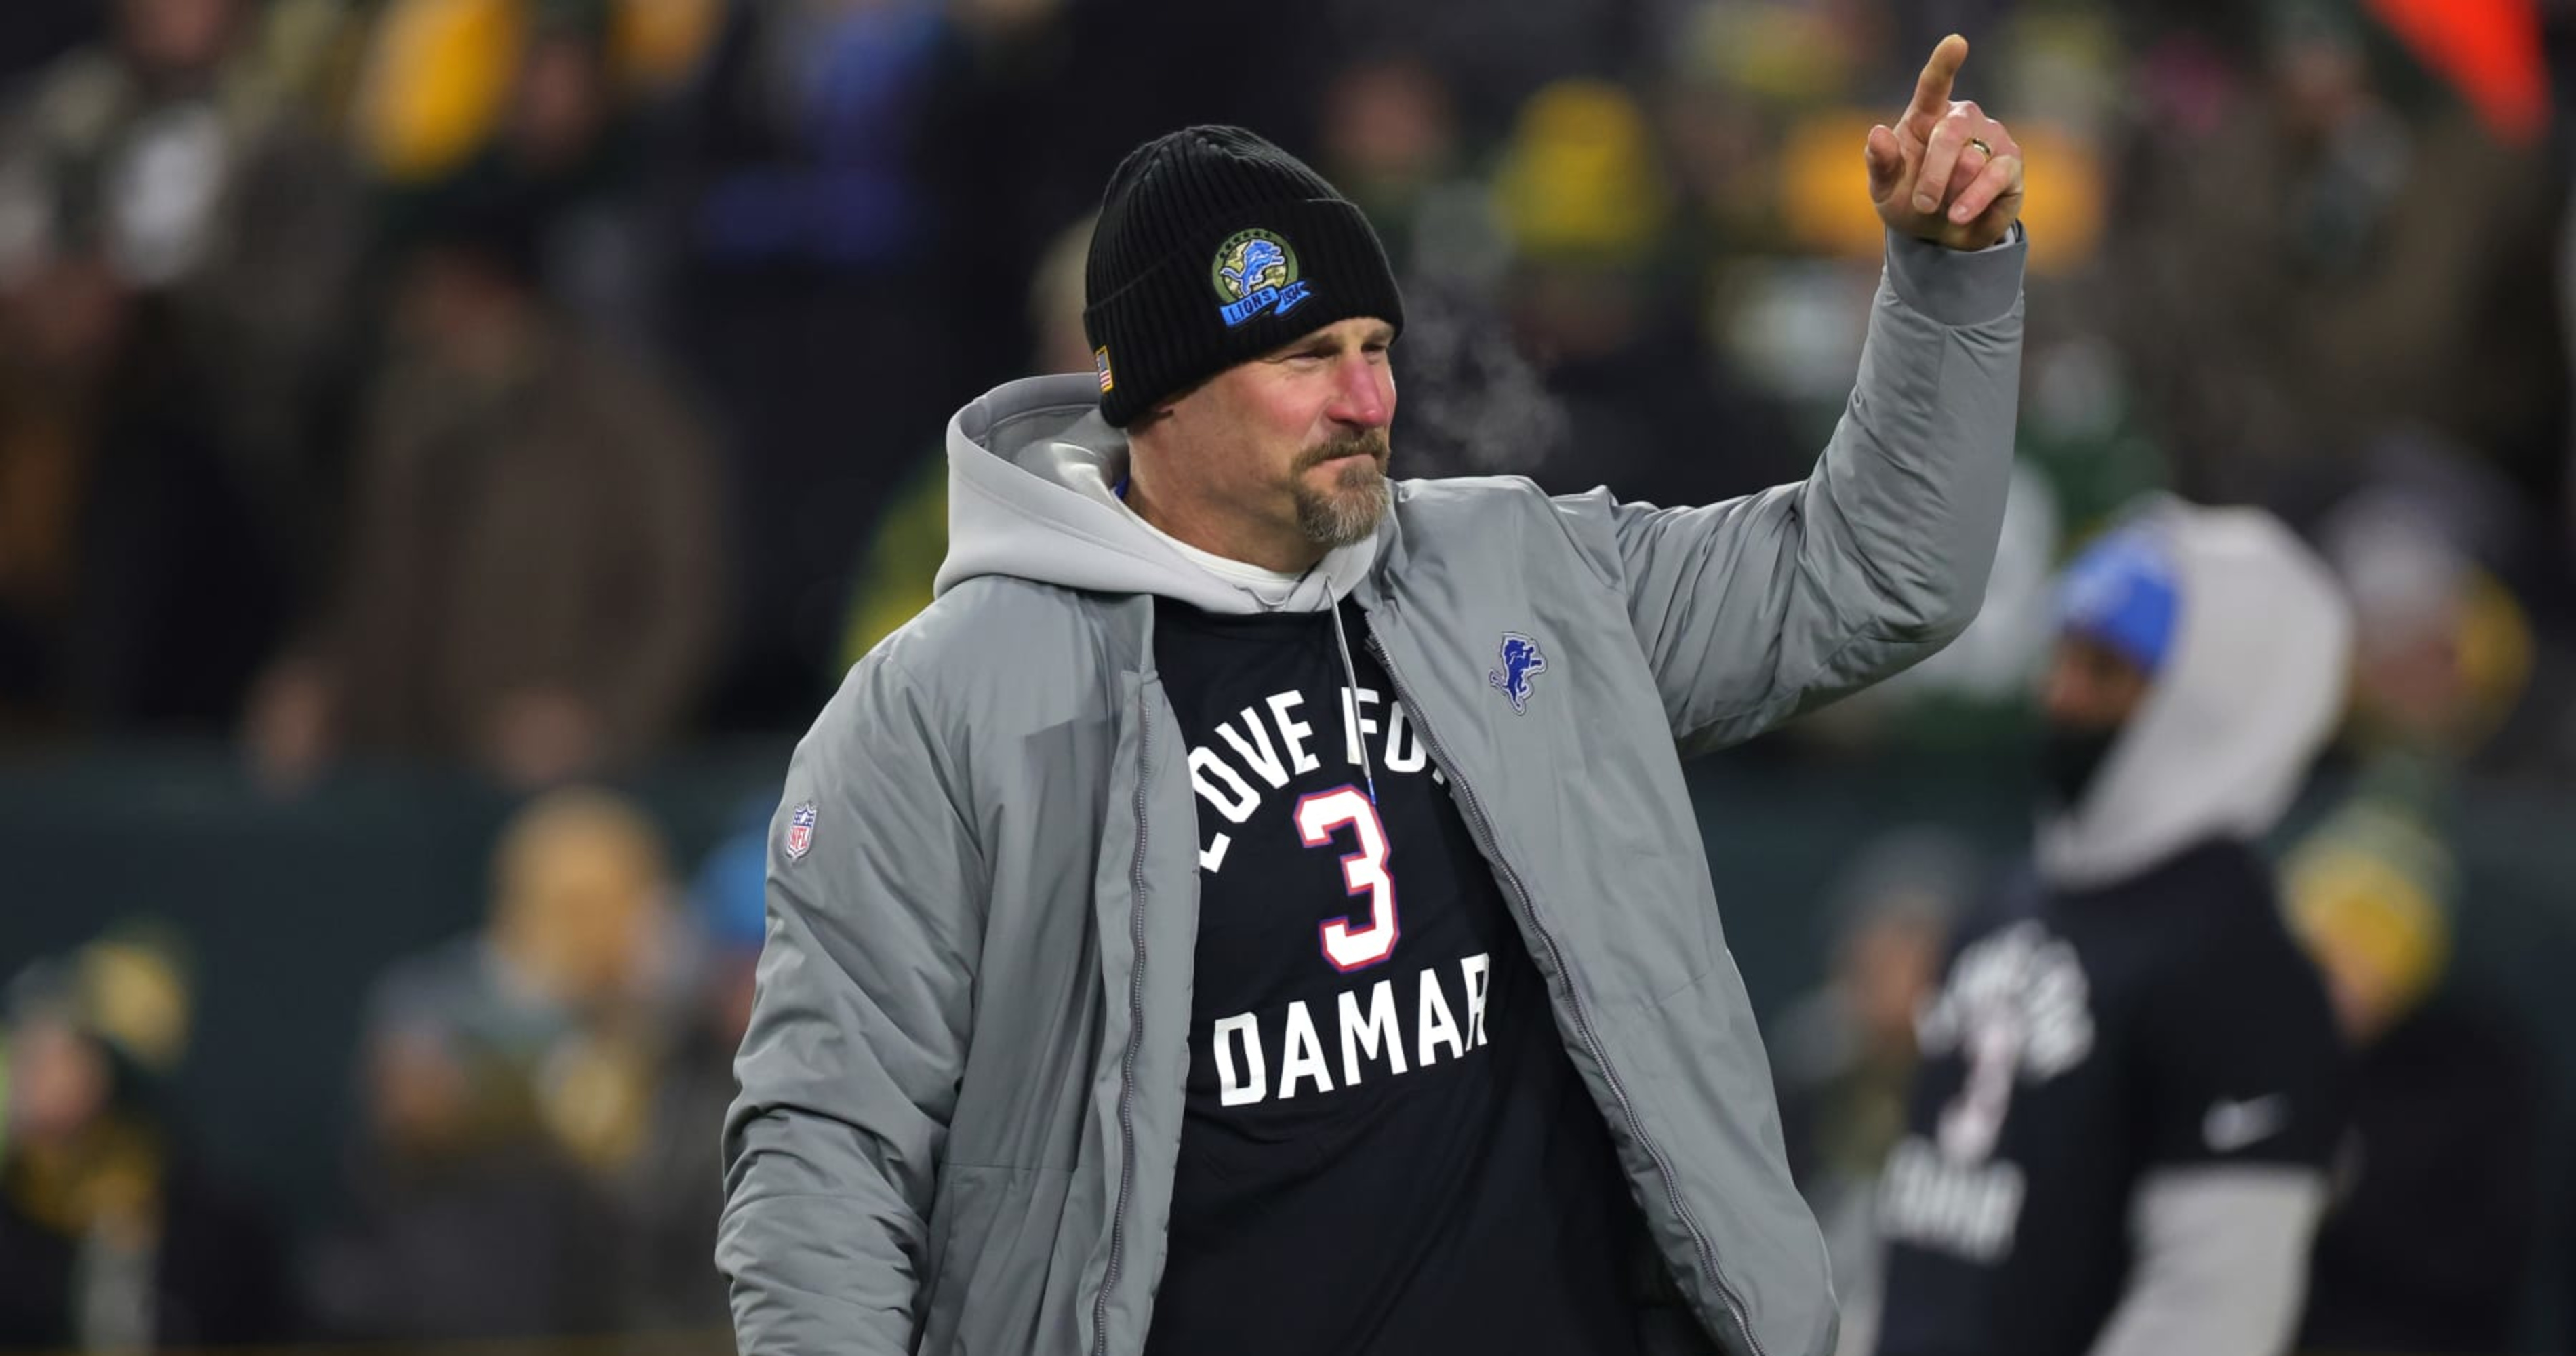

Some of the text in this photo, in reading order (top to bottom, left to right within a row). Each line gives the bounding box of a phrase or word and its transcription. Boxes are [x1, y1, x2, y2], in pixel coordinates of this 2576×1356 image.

[1228, 290, 1272, 323] LIONS
[1341, 687, 1444, 786] FO
[1293, 784, 1401, 974] 3
[1213, 953, 1490, 1106] DAMAR
